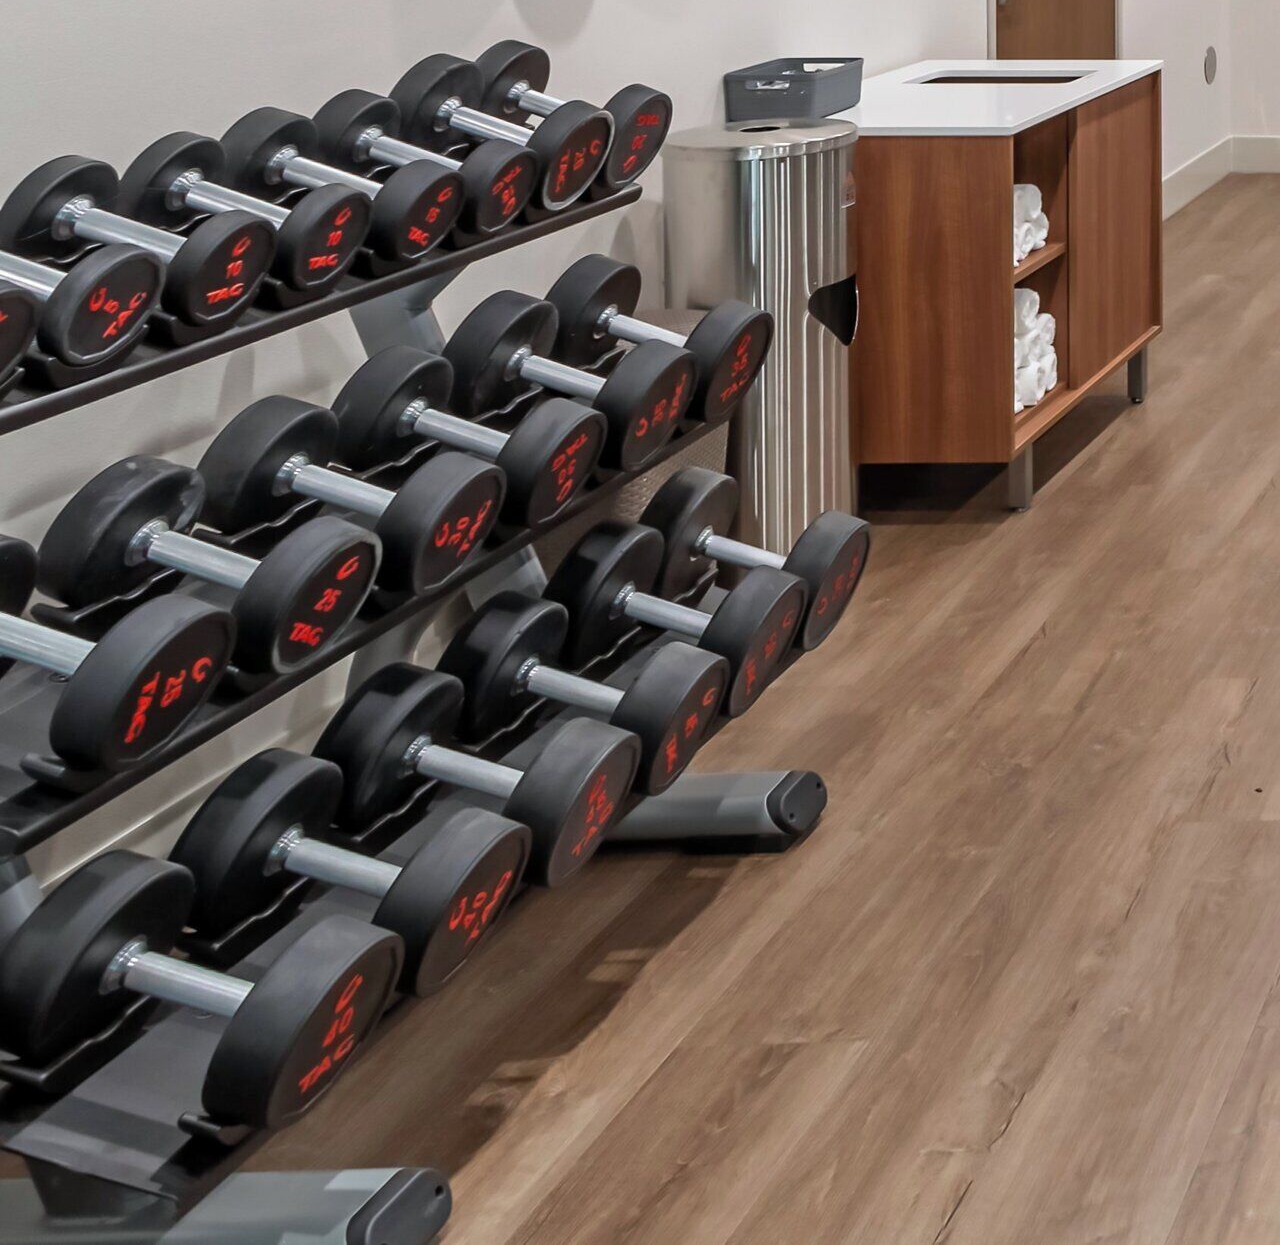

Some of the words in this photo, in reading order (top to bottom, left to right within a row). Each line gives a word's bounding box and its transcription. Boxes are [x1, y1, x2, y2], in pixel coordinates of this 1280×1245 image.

[326, 229, 344, 247] 10
[408, 225, 430, 247] TAG
[226, 259, 244, 279] 10
[308, 253, 339, 272] TAG
[206, 282, 244, 305] TAG
[314, 586, 343, 613] 25
[288, 620, 325, 648] TAG
[123, 671, 163, 745] TAG
